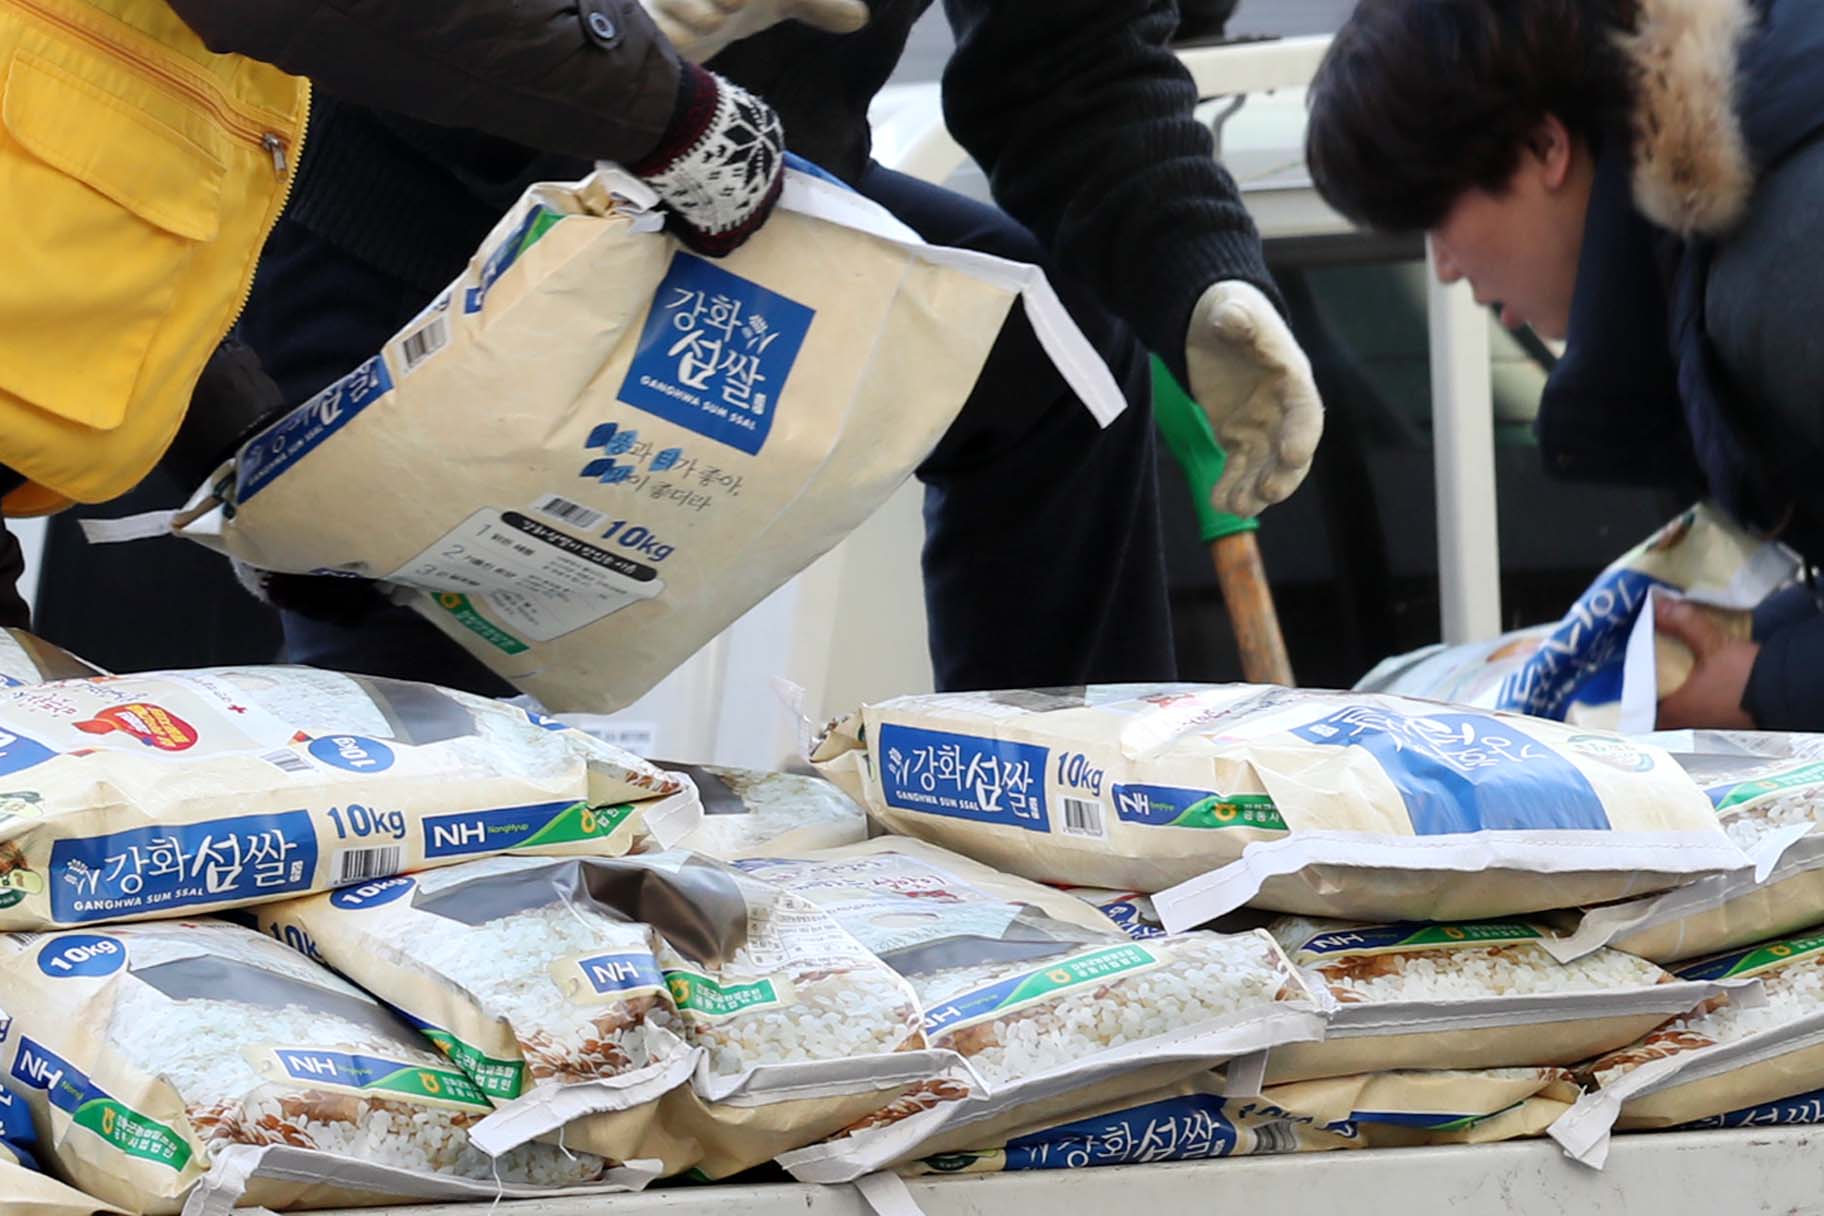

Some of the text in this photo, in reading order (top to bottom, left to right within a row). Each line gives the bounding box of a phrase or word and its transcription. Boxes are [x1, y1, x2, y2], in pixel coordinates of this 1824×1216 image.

[665, 287, 742, 343] 강화
[667, 329, 766, 410] 섬쌀
[640, 375, 758, 431] GANGHWA SUM SSAL
[650, 480, 712, 512] 좋더라
[698, 465, 743, 496] 좋아,
[476, 524, 492, 537] 1
[600, 520, 675, 562] 10kg
[443, 544, 465, 558] 2
[331, 735, 376, 769] 10kg
[911, 744, 1034, 819] 강화섬쌀
[1057, 751, 1104, 798] 10kg
[895, 789, 980, 811] GANGHWA SUM SSAL
[1119, 792, 1152, 816] NH
[328, 803, 406, 839] 10kg
[433, 820, 487, 849] NH
[104, 829, 297, 895] 강화섬쌀
[74, 887, 204, 913] GANGHWA SUM SSAL
[51, 940, 119, 971] 10kg
[1314, 932, 1365, 953] NH
[592, 960, 640, 984] NH
[20, 1049, 64, 1090] NH
[288, 1054, 338, 1077] NH
